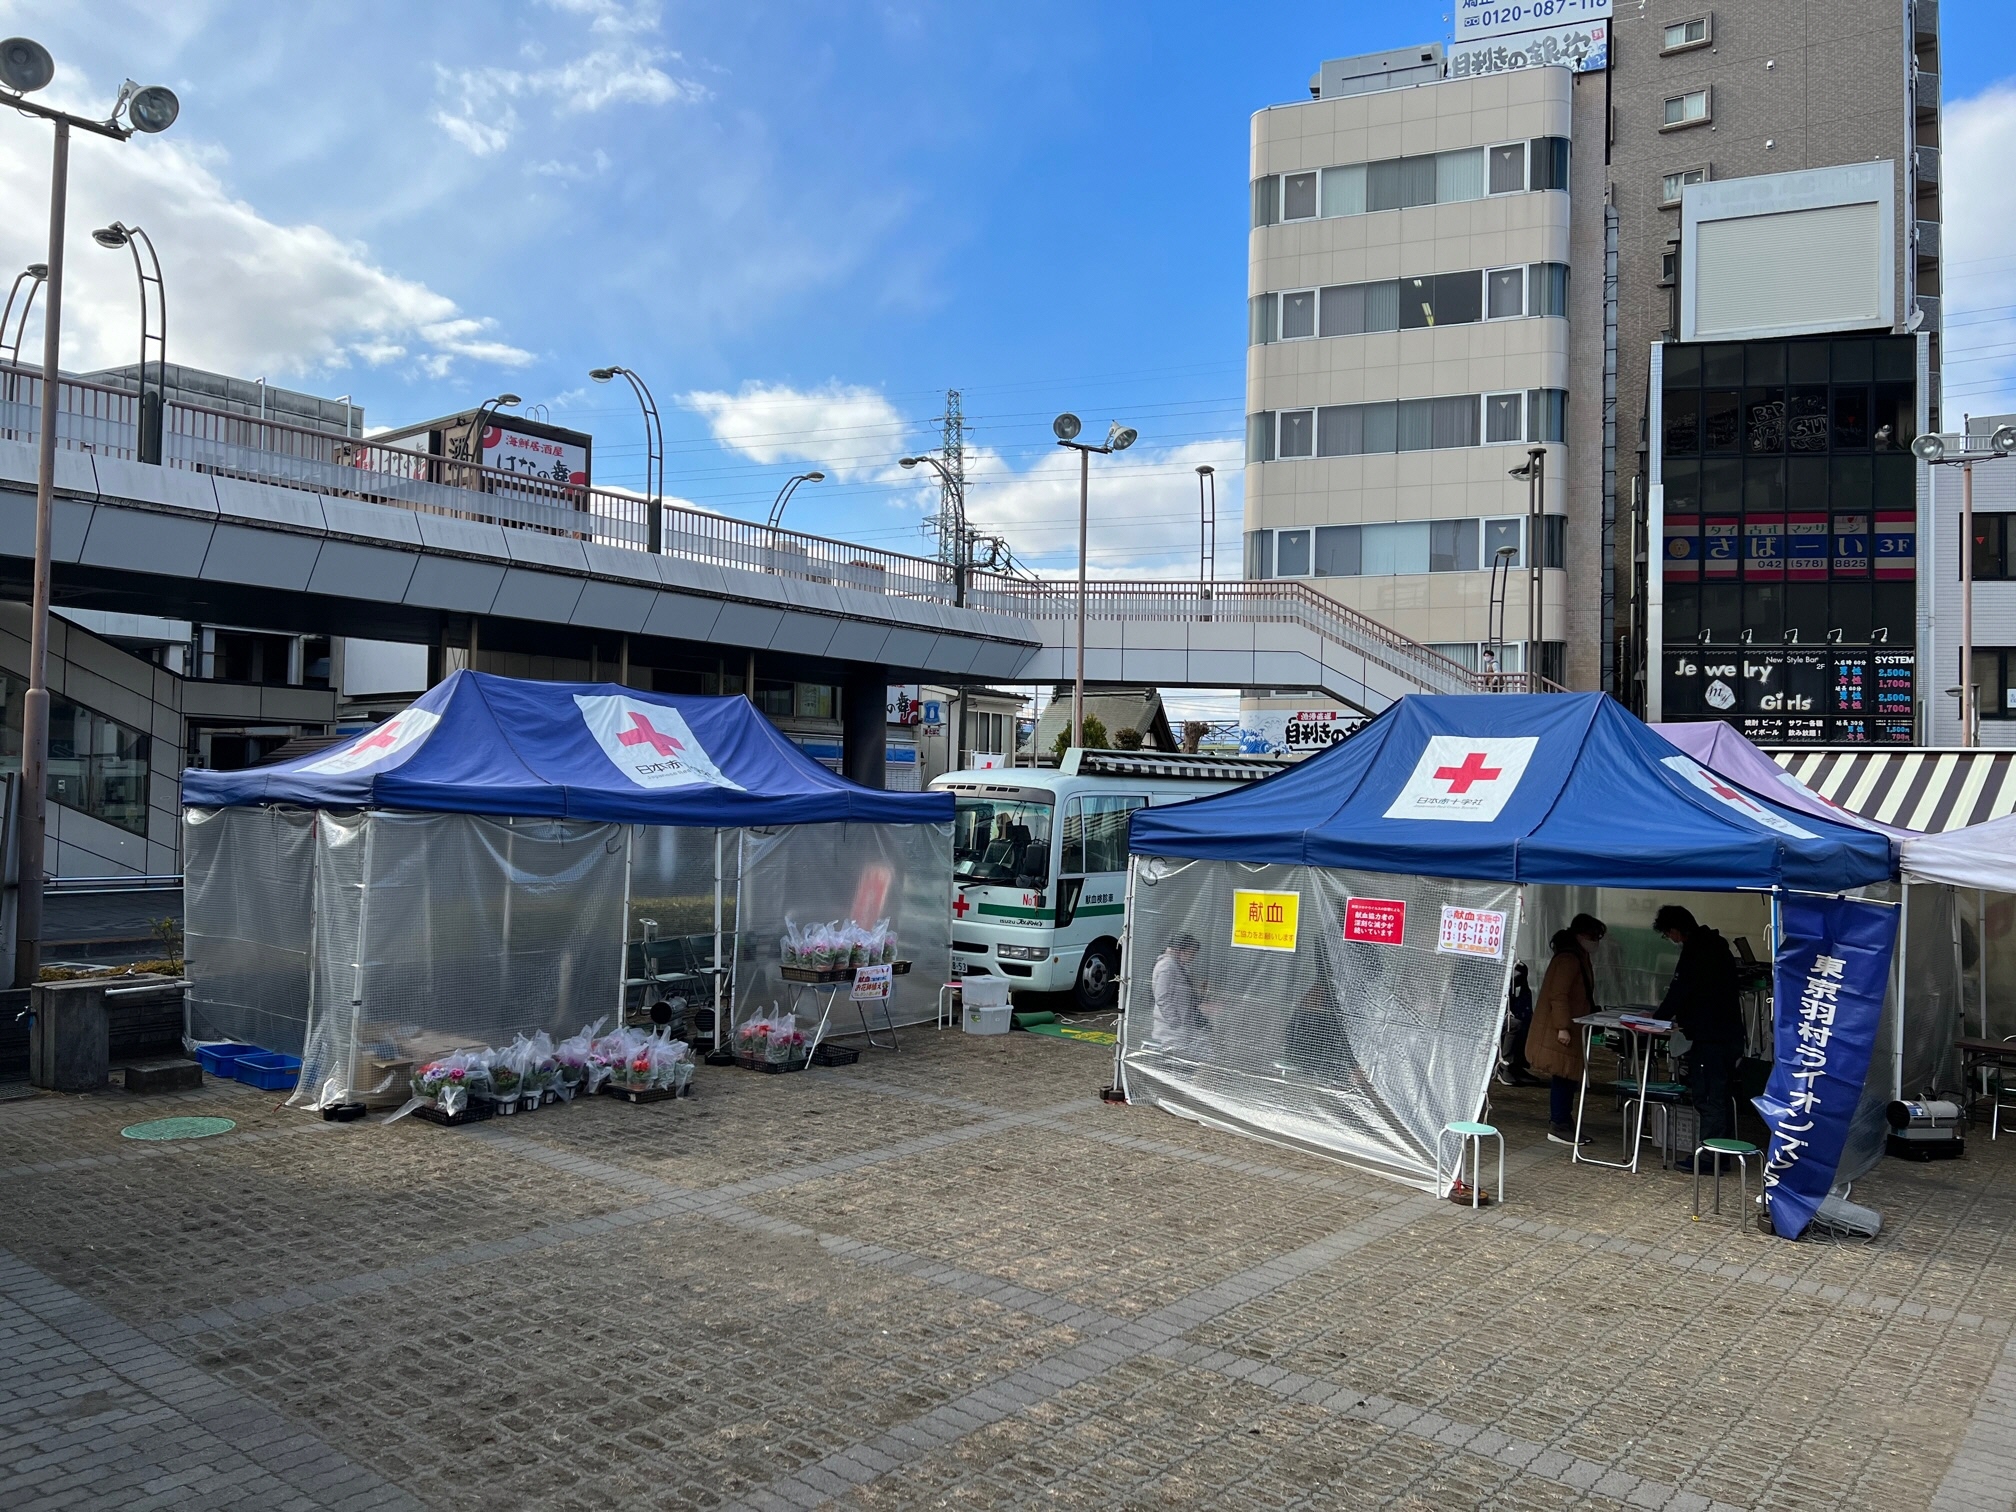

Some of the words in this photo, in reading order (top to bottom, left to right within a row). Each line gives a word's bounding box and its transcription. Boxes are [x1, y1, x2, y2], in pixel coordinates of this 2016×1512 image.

[506, 435, 564, 457] 海鮮居酒屋
[1880, 539, 1910, 552] 3F
[1758, 560, 1782, 568] 042
[1791, 560, 1823, 568] (578)
[1835, 560, 1866, 568] 8825
[1787, 656, 1804, 664] Style
[1874, 656, 1914, 664] SYSTEM
[1249, 901, 1284, 923] 献血
